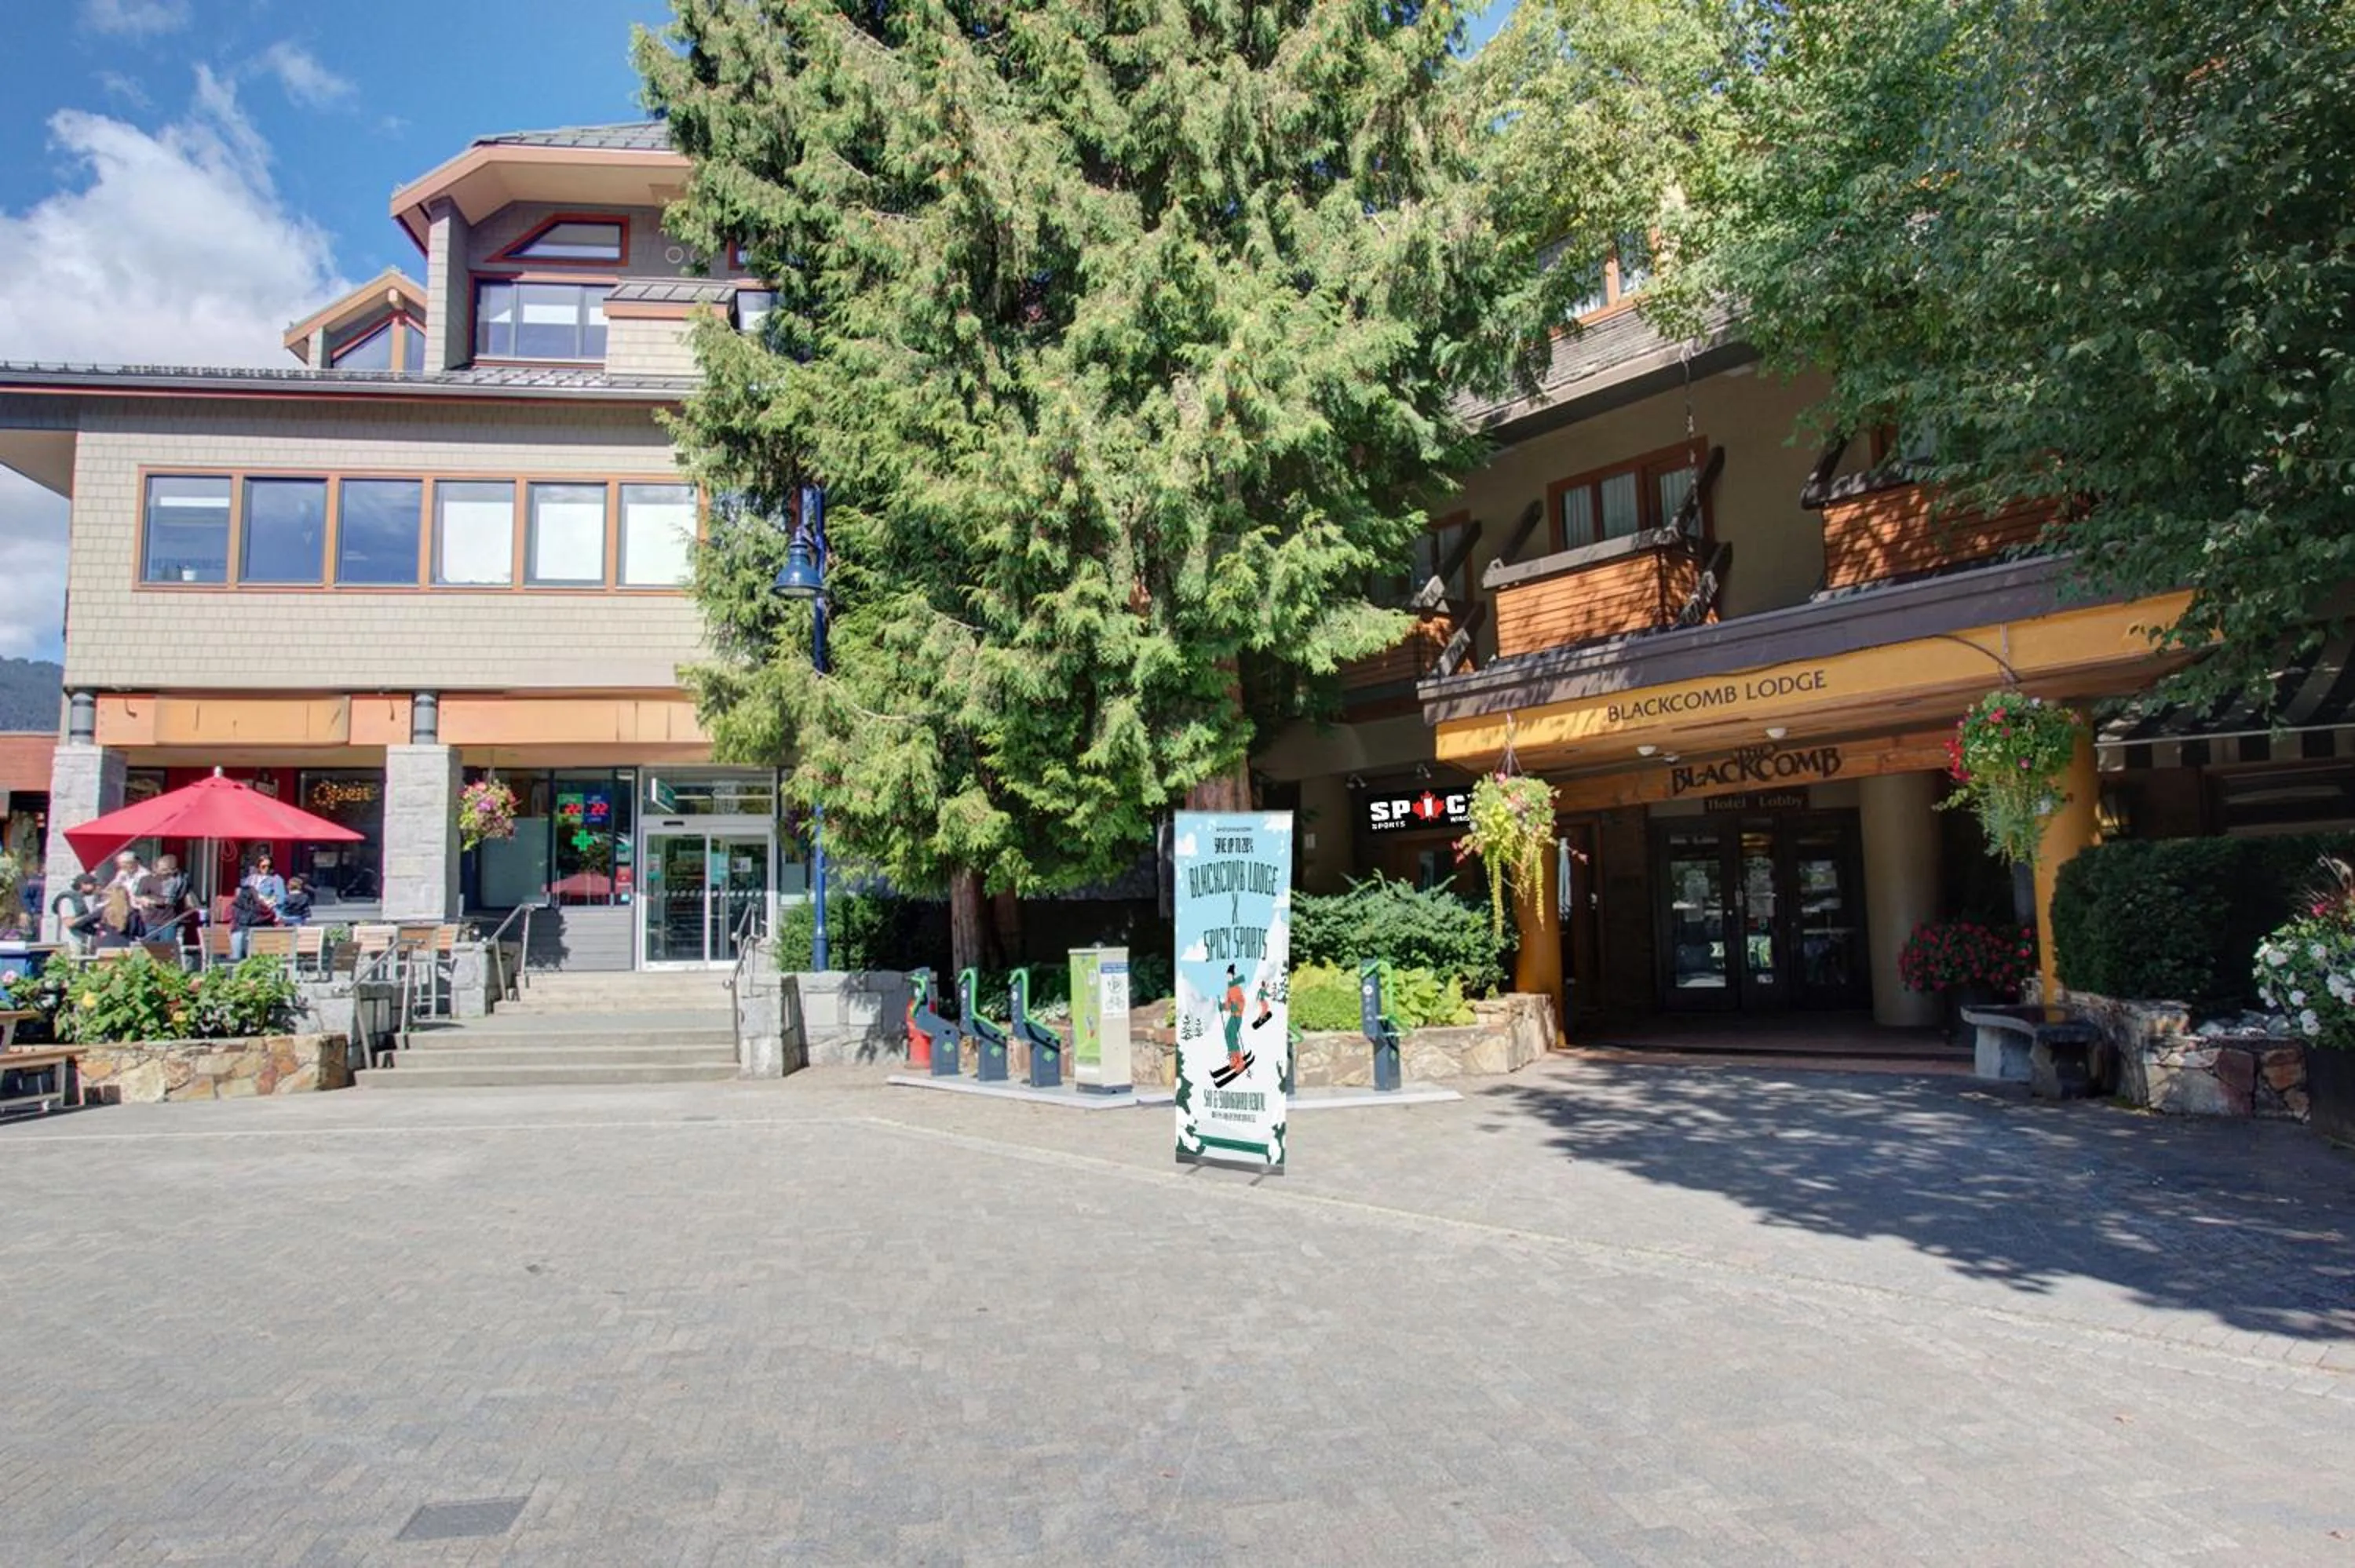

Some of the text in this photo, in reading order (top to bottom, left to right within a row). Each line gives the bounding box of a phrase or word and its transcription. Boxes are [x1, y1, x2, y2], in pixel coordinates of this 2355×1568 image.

[1608, 670, 1827, 723] BLACKCOMB LODGE
[1672, 747, 1841, 794] BLACKCOMB
[1370, 794, 1471, 821] SPIC
[1708, 793, 1803, 810] Hotel Lobby
[1371, 821, 1406, 830] SPORTS
[1188, 860, 1279, 899] BLACKCOMB LODGE
[1203, 927, 1268, 962] SPICY SPORTS
